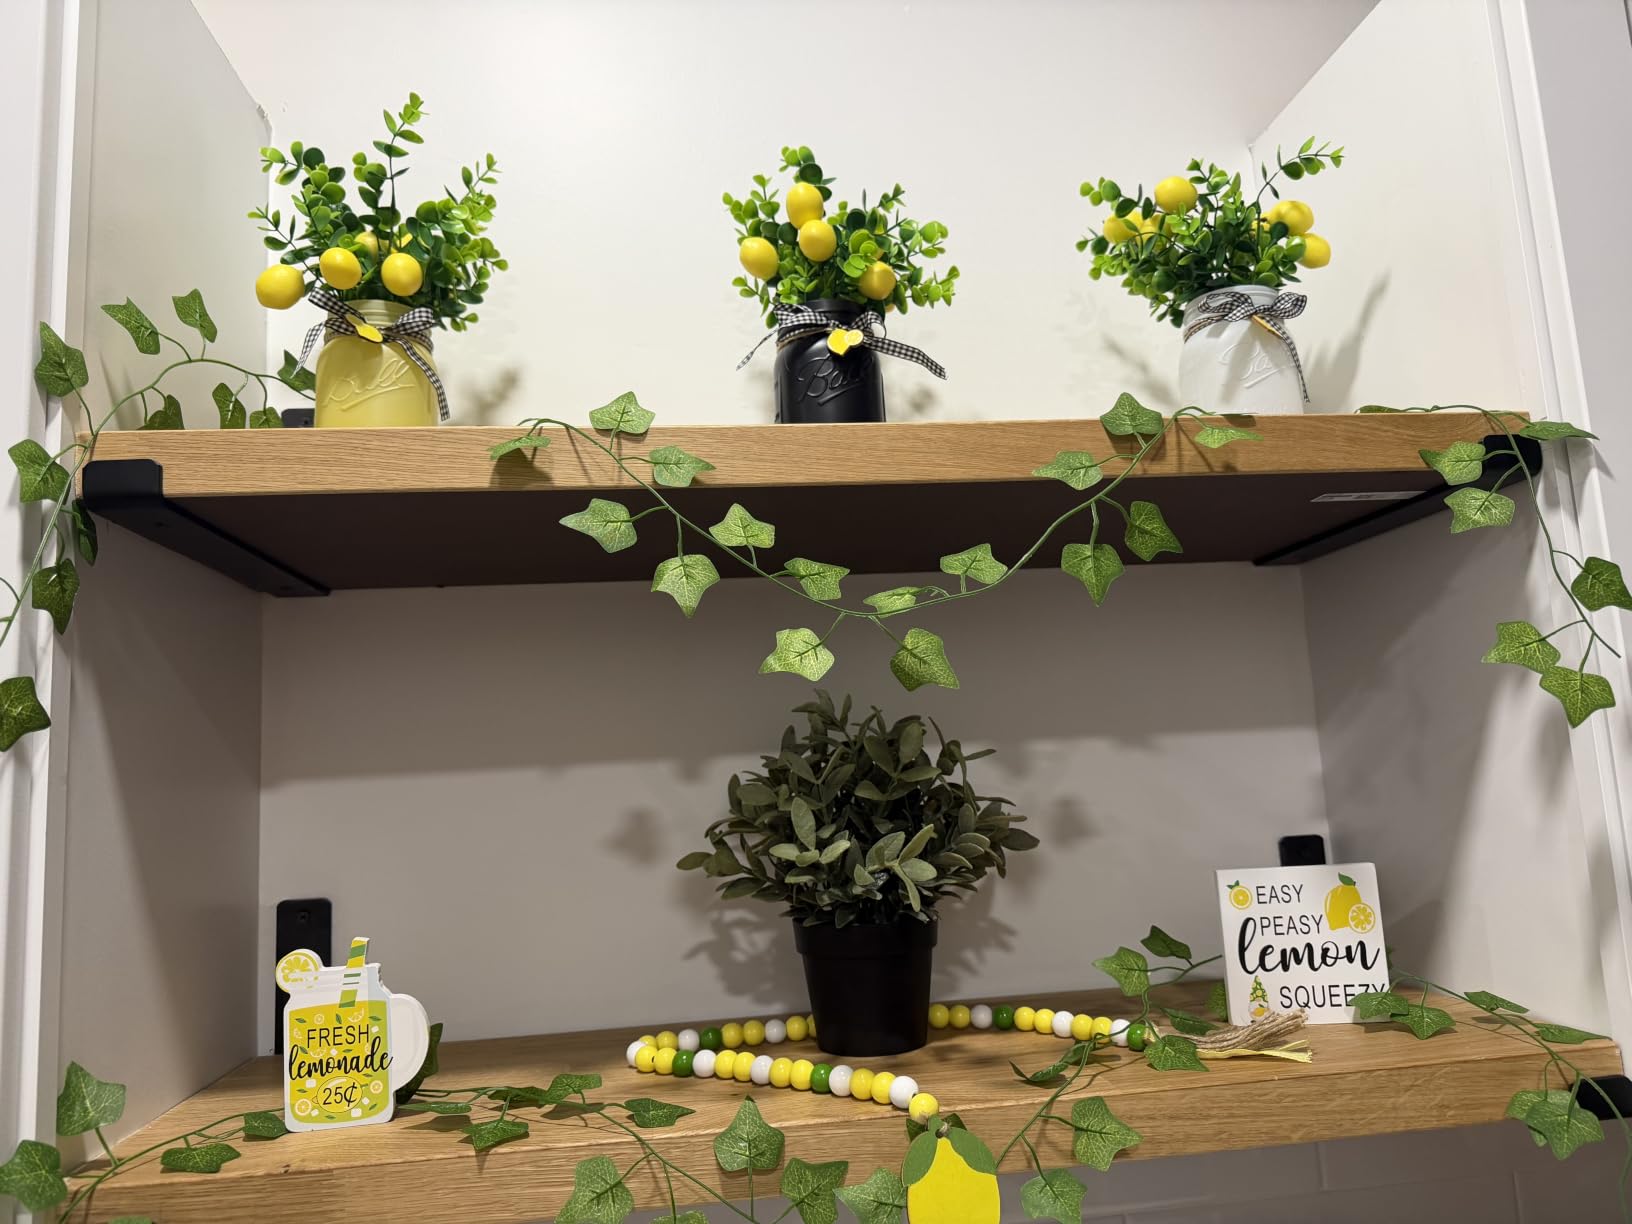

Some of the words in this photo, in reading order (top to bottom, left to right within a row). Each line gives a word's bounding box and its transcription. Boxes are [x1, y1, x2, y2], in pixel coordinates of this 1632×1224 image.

[1256, 884, 1303, 904] EASY
[1260, 914, 1323, 936] PEASY
[1238, 917, 1380, 975] lemon
[307, 1023, 370, 1048] FRESH
[289, 1035, 394, 1080] lemonade
[322, 1082, 358, 1107] 25¢
